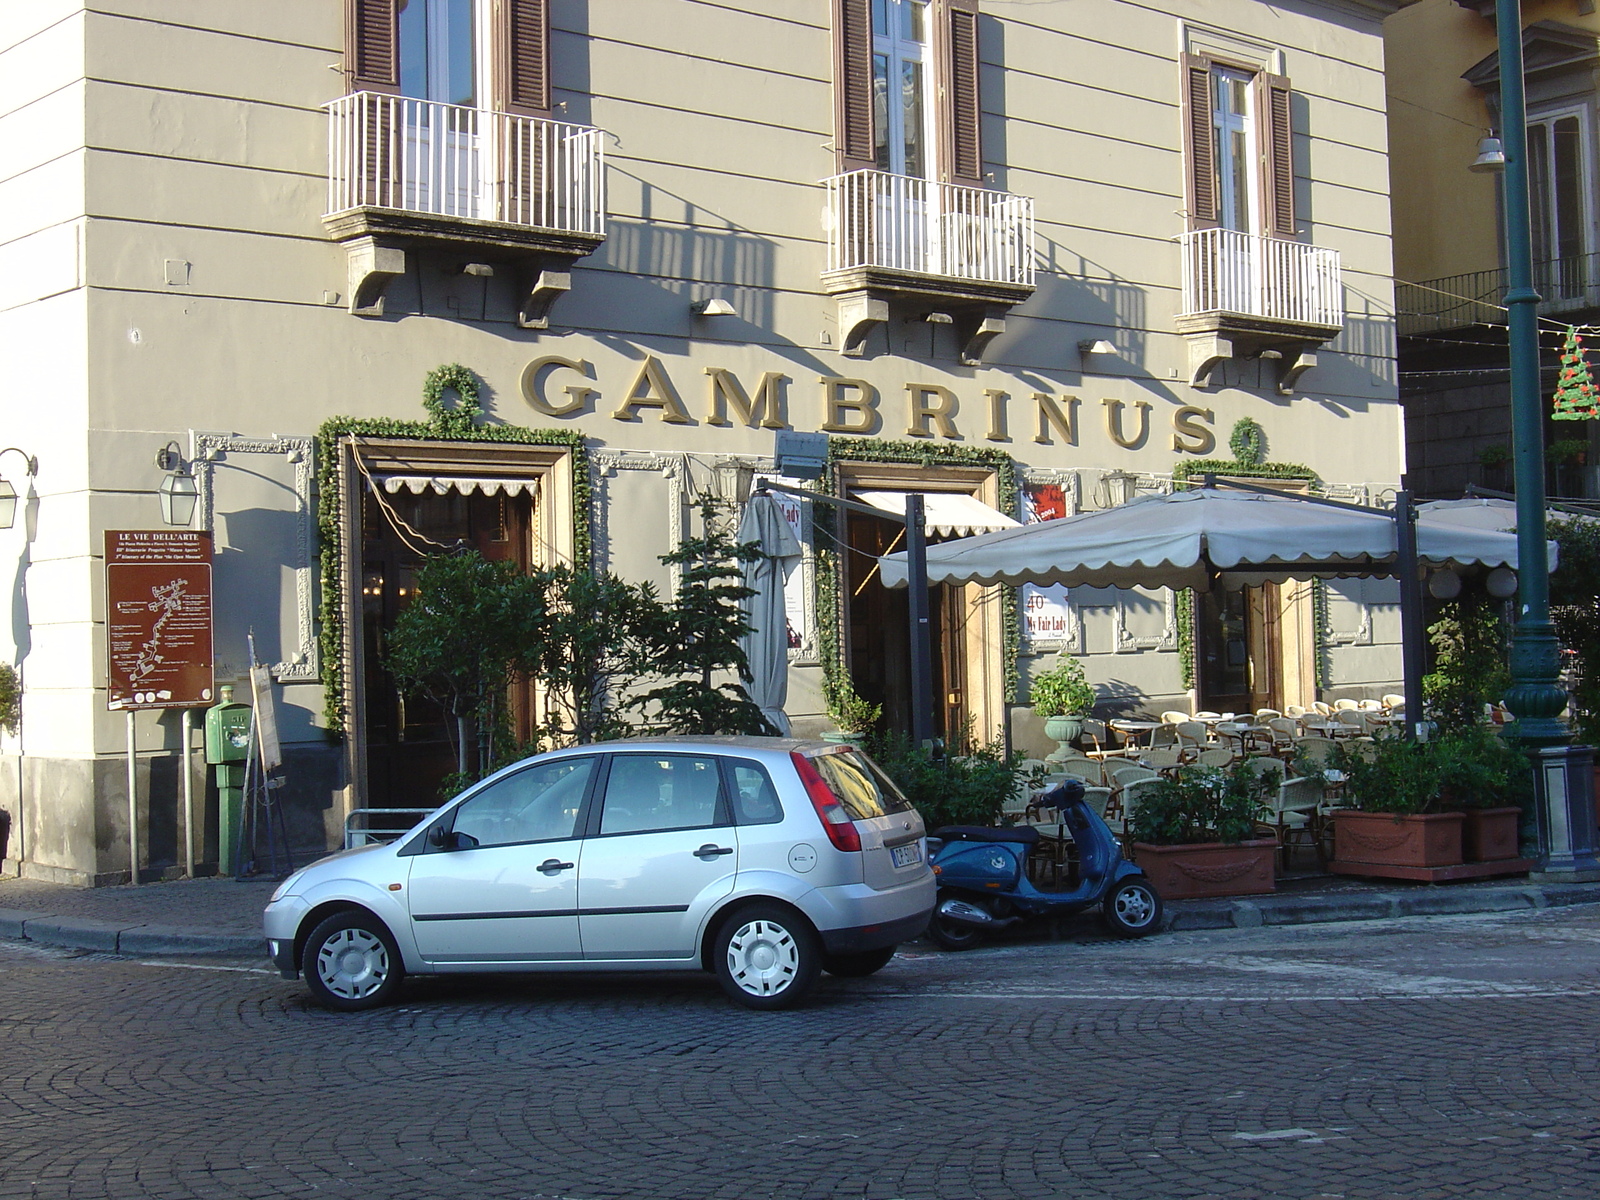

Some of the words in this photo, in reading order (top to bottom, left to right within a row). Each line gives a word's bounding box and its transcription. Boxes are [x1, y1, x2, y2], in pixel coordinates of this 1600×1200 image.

[519, 353, 1217, 455] GAMBRINUS
[119, 533, 131, 541] LE
[133, 533, 149, 541] VIE
[152, 533, 199, 541] DELL'ARTE
[1038, 616, 1051, 631] Fair
[1052, 616, 1066, 634] Lady
